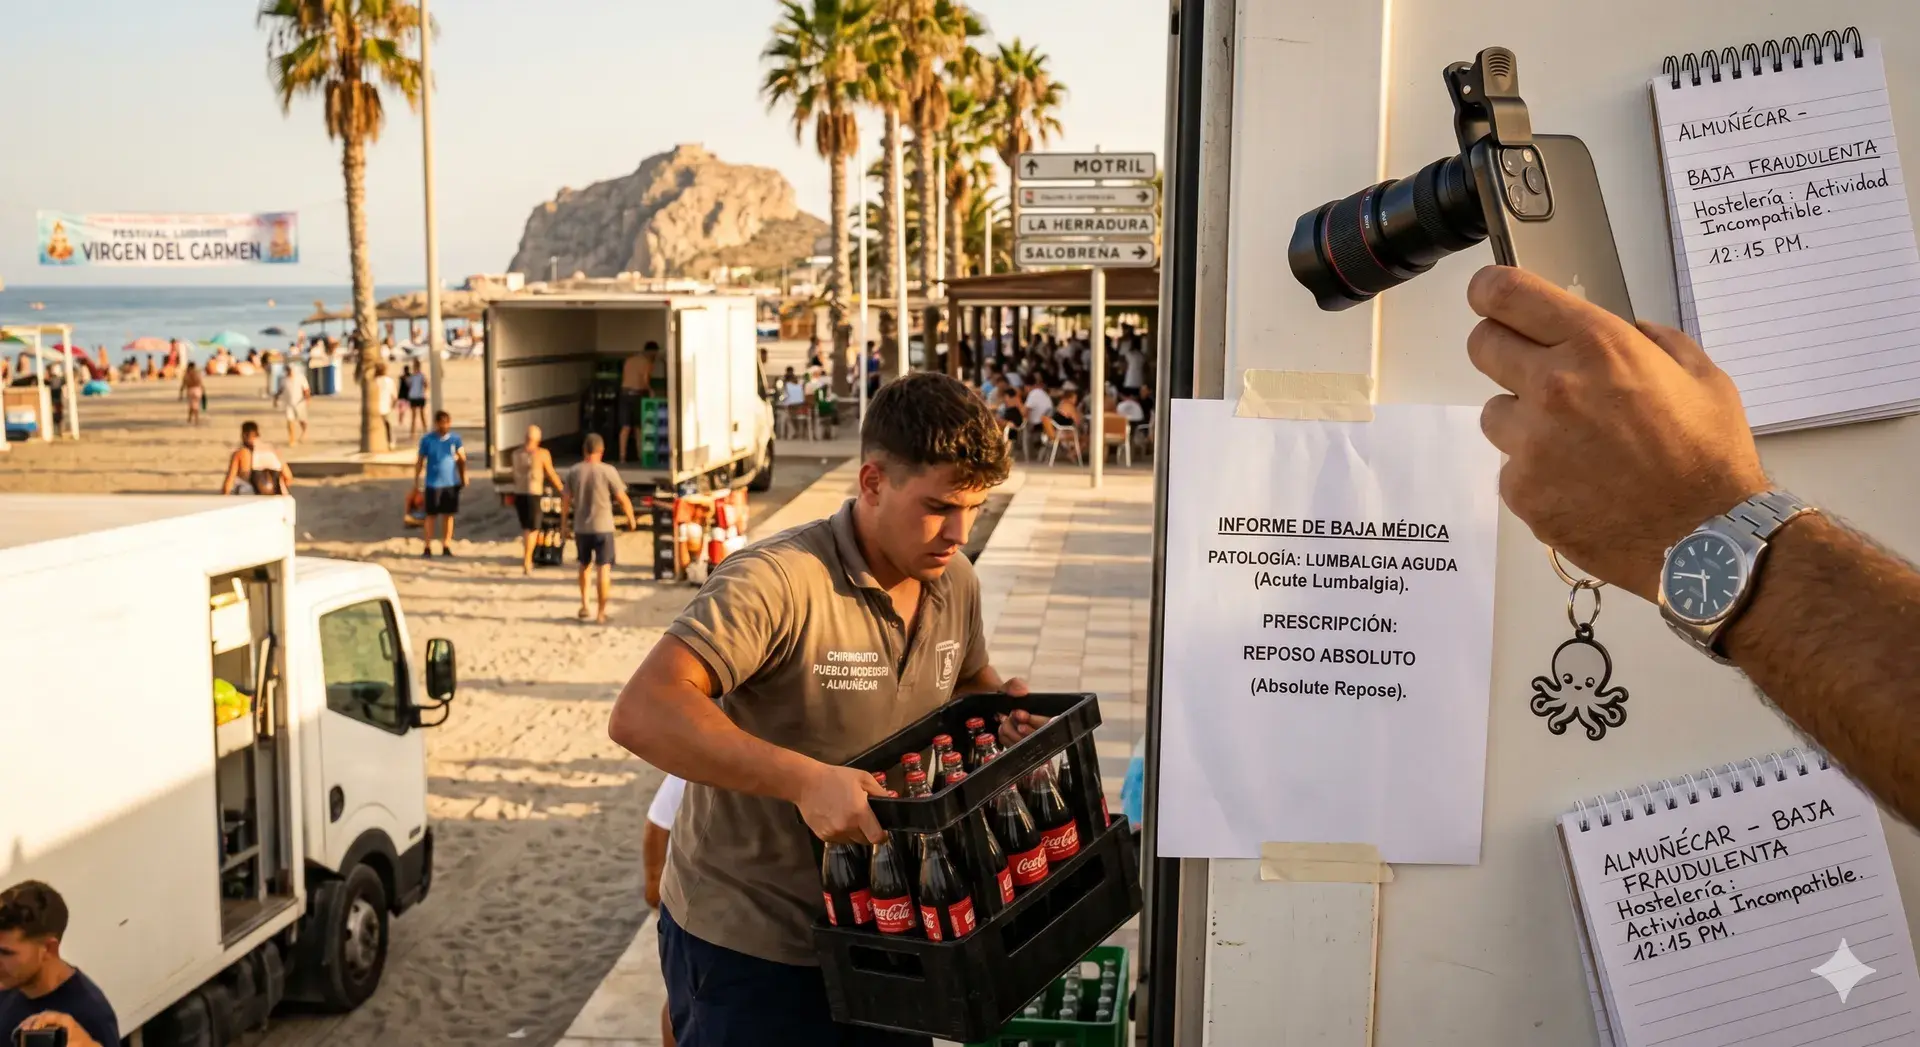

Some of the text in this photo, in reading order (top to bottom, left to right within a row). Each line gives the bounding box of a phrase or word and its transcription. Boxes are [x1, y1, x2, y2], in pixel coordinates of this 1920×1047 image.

[1074, 159, 1145, 173] MOTRIL
[1687, 139, 1878, 186] BAJA FRAUDULENTA
[1805, 168, 1889, 200] Actividad
[1029, 219, 1149, 230] LA HERRADURA
[1700, 202, 1831, 236] Incompatible.
[81, 242, 261, 260] VIRGEN DEL CARMEN
[1709, 235, 1809, 264] 12:15 PM.
[1218, 517, 1449, 539] INFORME DE BAJA MÉDICA
[1208, 549, 1458, 572] PATOLOGÍA: LUMBALGIA AGUDA
[1254, 571, 1409, 594] (Acute Lumbalgia).
[1263, 614, 1397, 633] PRESCRIPCIÓN:
[1243, 645, 1416, 666] REPOSO ABSOLUTO
[813, 664, 848, 676] PUEBLO
[826, 678, 877, 690] ALMUÑÉCAR
[1251, 678, 1407, 701] (Absolute Repose).
[1604, 825, 1735, 875] ALMUÑÉCAR
[1772, 799, 1835, 831] BAJA
[1623, 839, 1788, 894] FRAUDULENTA
[1627, 866, 1864, 942] Actividad Incompatible.
[1633, 921, 1735, 961] 12:15 PM.
